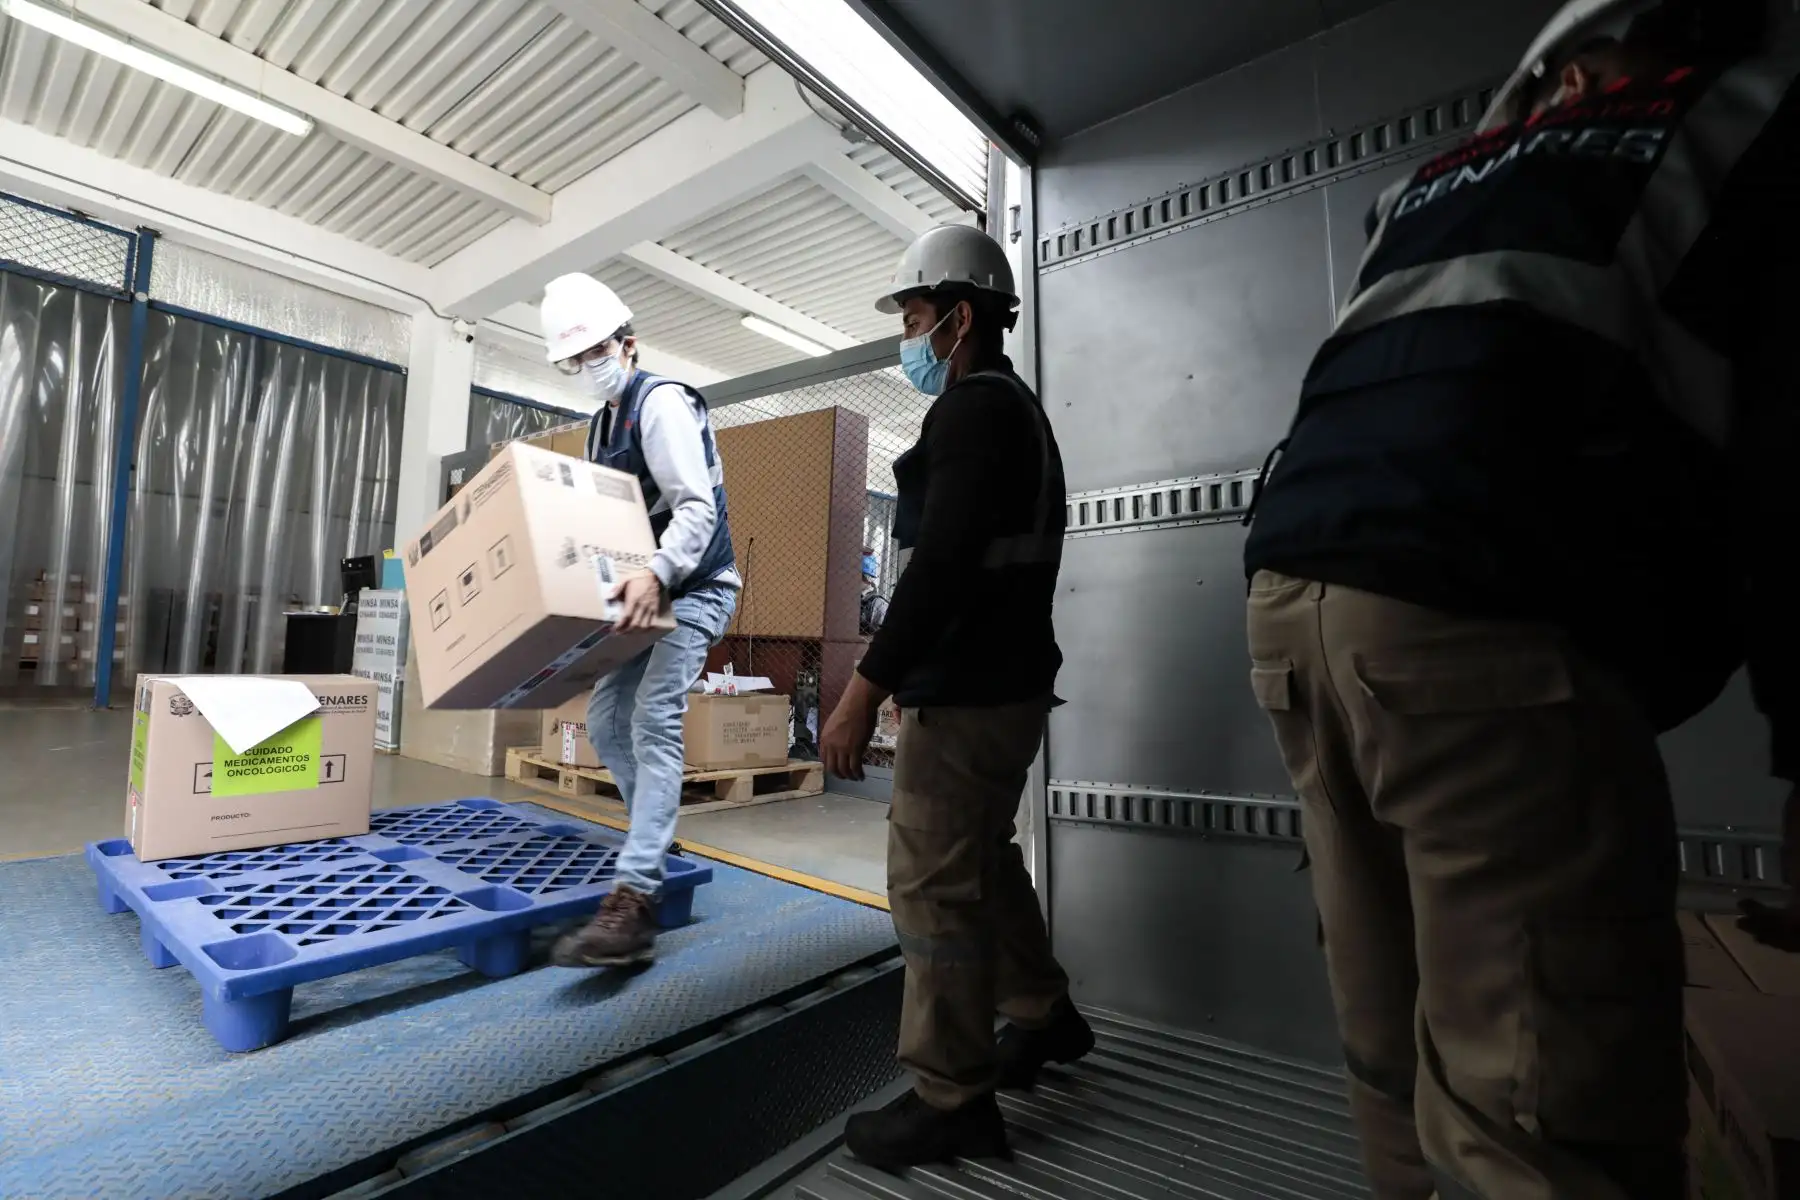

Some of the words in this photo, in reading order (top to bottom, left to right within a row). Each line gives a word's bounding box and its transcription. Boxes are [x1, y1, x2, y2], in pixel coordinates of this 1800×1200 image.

[1394, 126, 1667, 219] CENARES
[315, 695, 368, 706] ENARES
[244, 746, 293, 757] CUIDADO
[224, 754, 310, 768] MEDICAMENTOS
